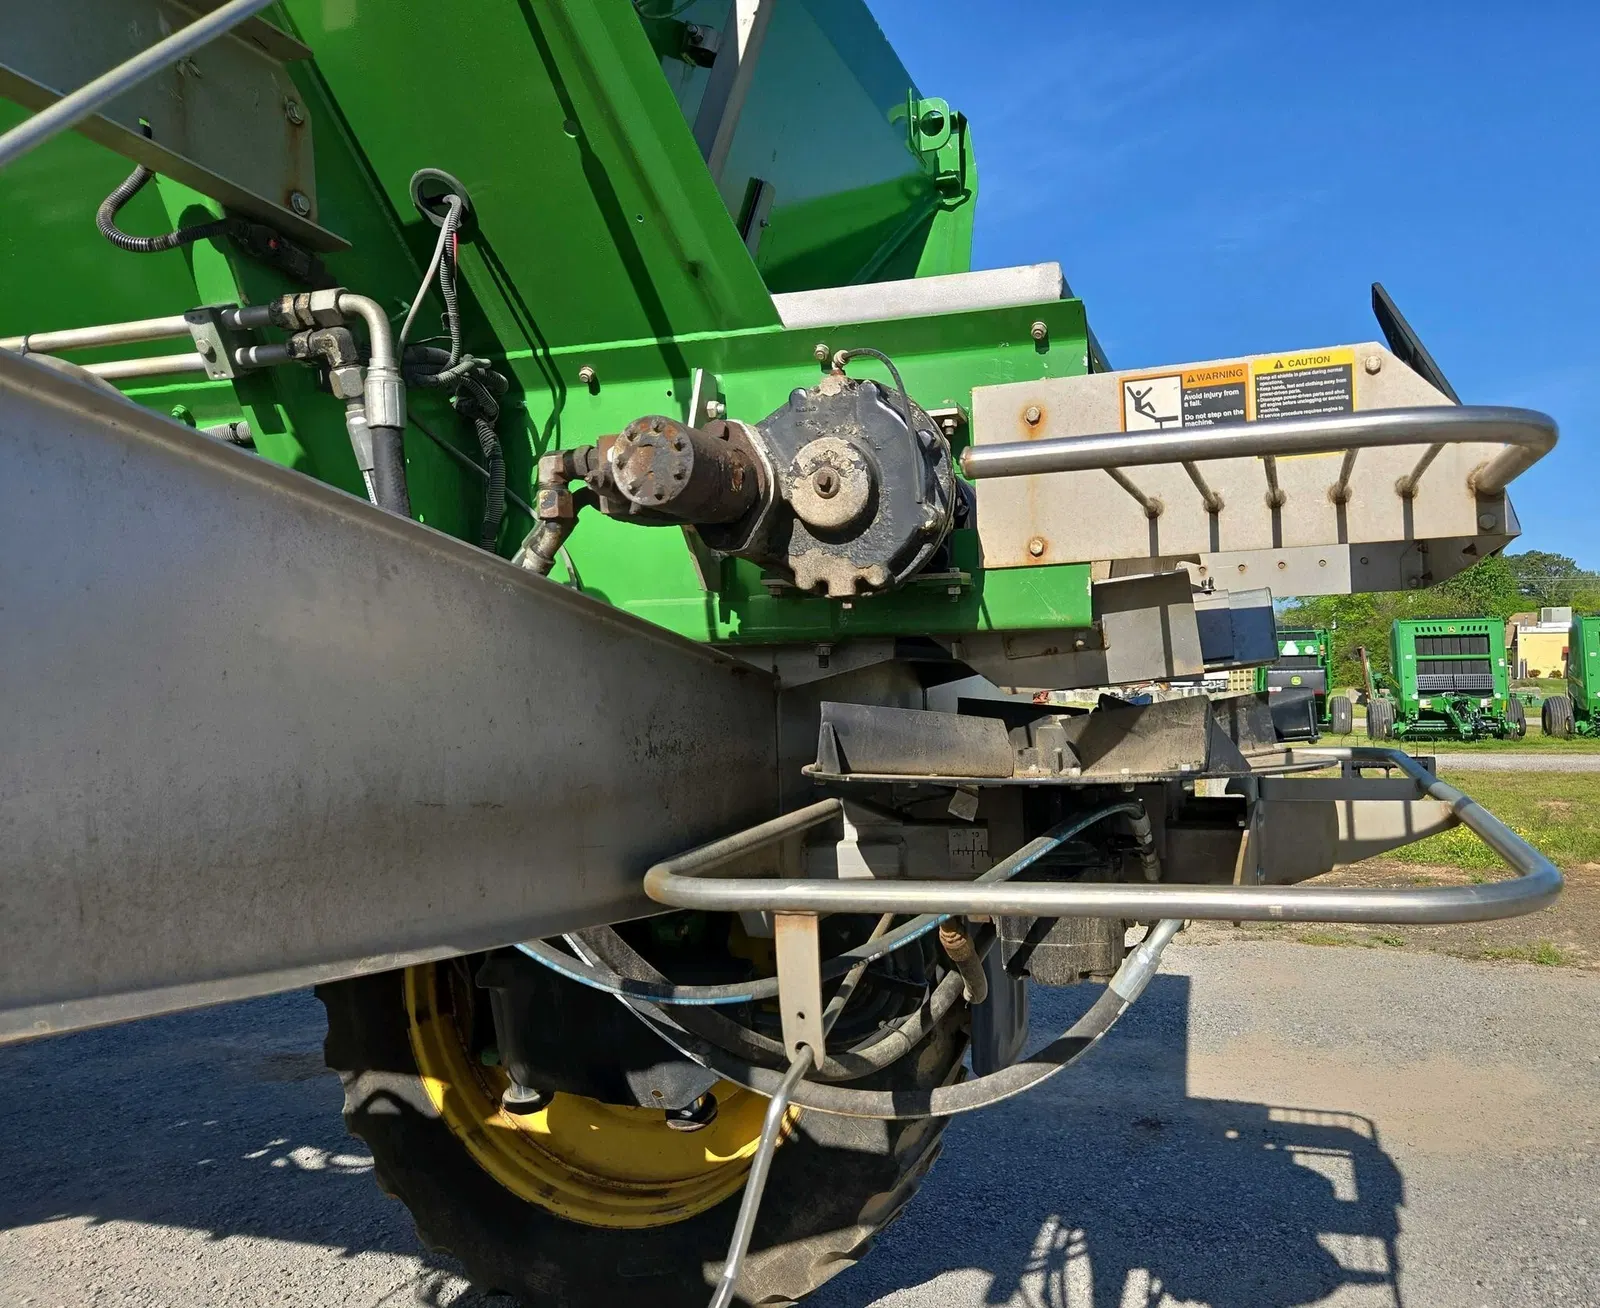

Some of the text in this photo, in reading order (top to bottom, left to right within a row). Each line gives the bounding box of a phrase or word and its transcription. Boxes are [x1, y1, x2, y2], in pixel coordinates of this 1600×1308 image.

[1288, 355, 1330, 367] CAUTION
[1197, 369, 1243, 381] WARNING
[1203, 391, 1222, 399] injury
